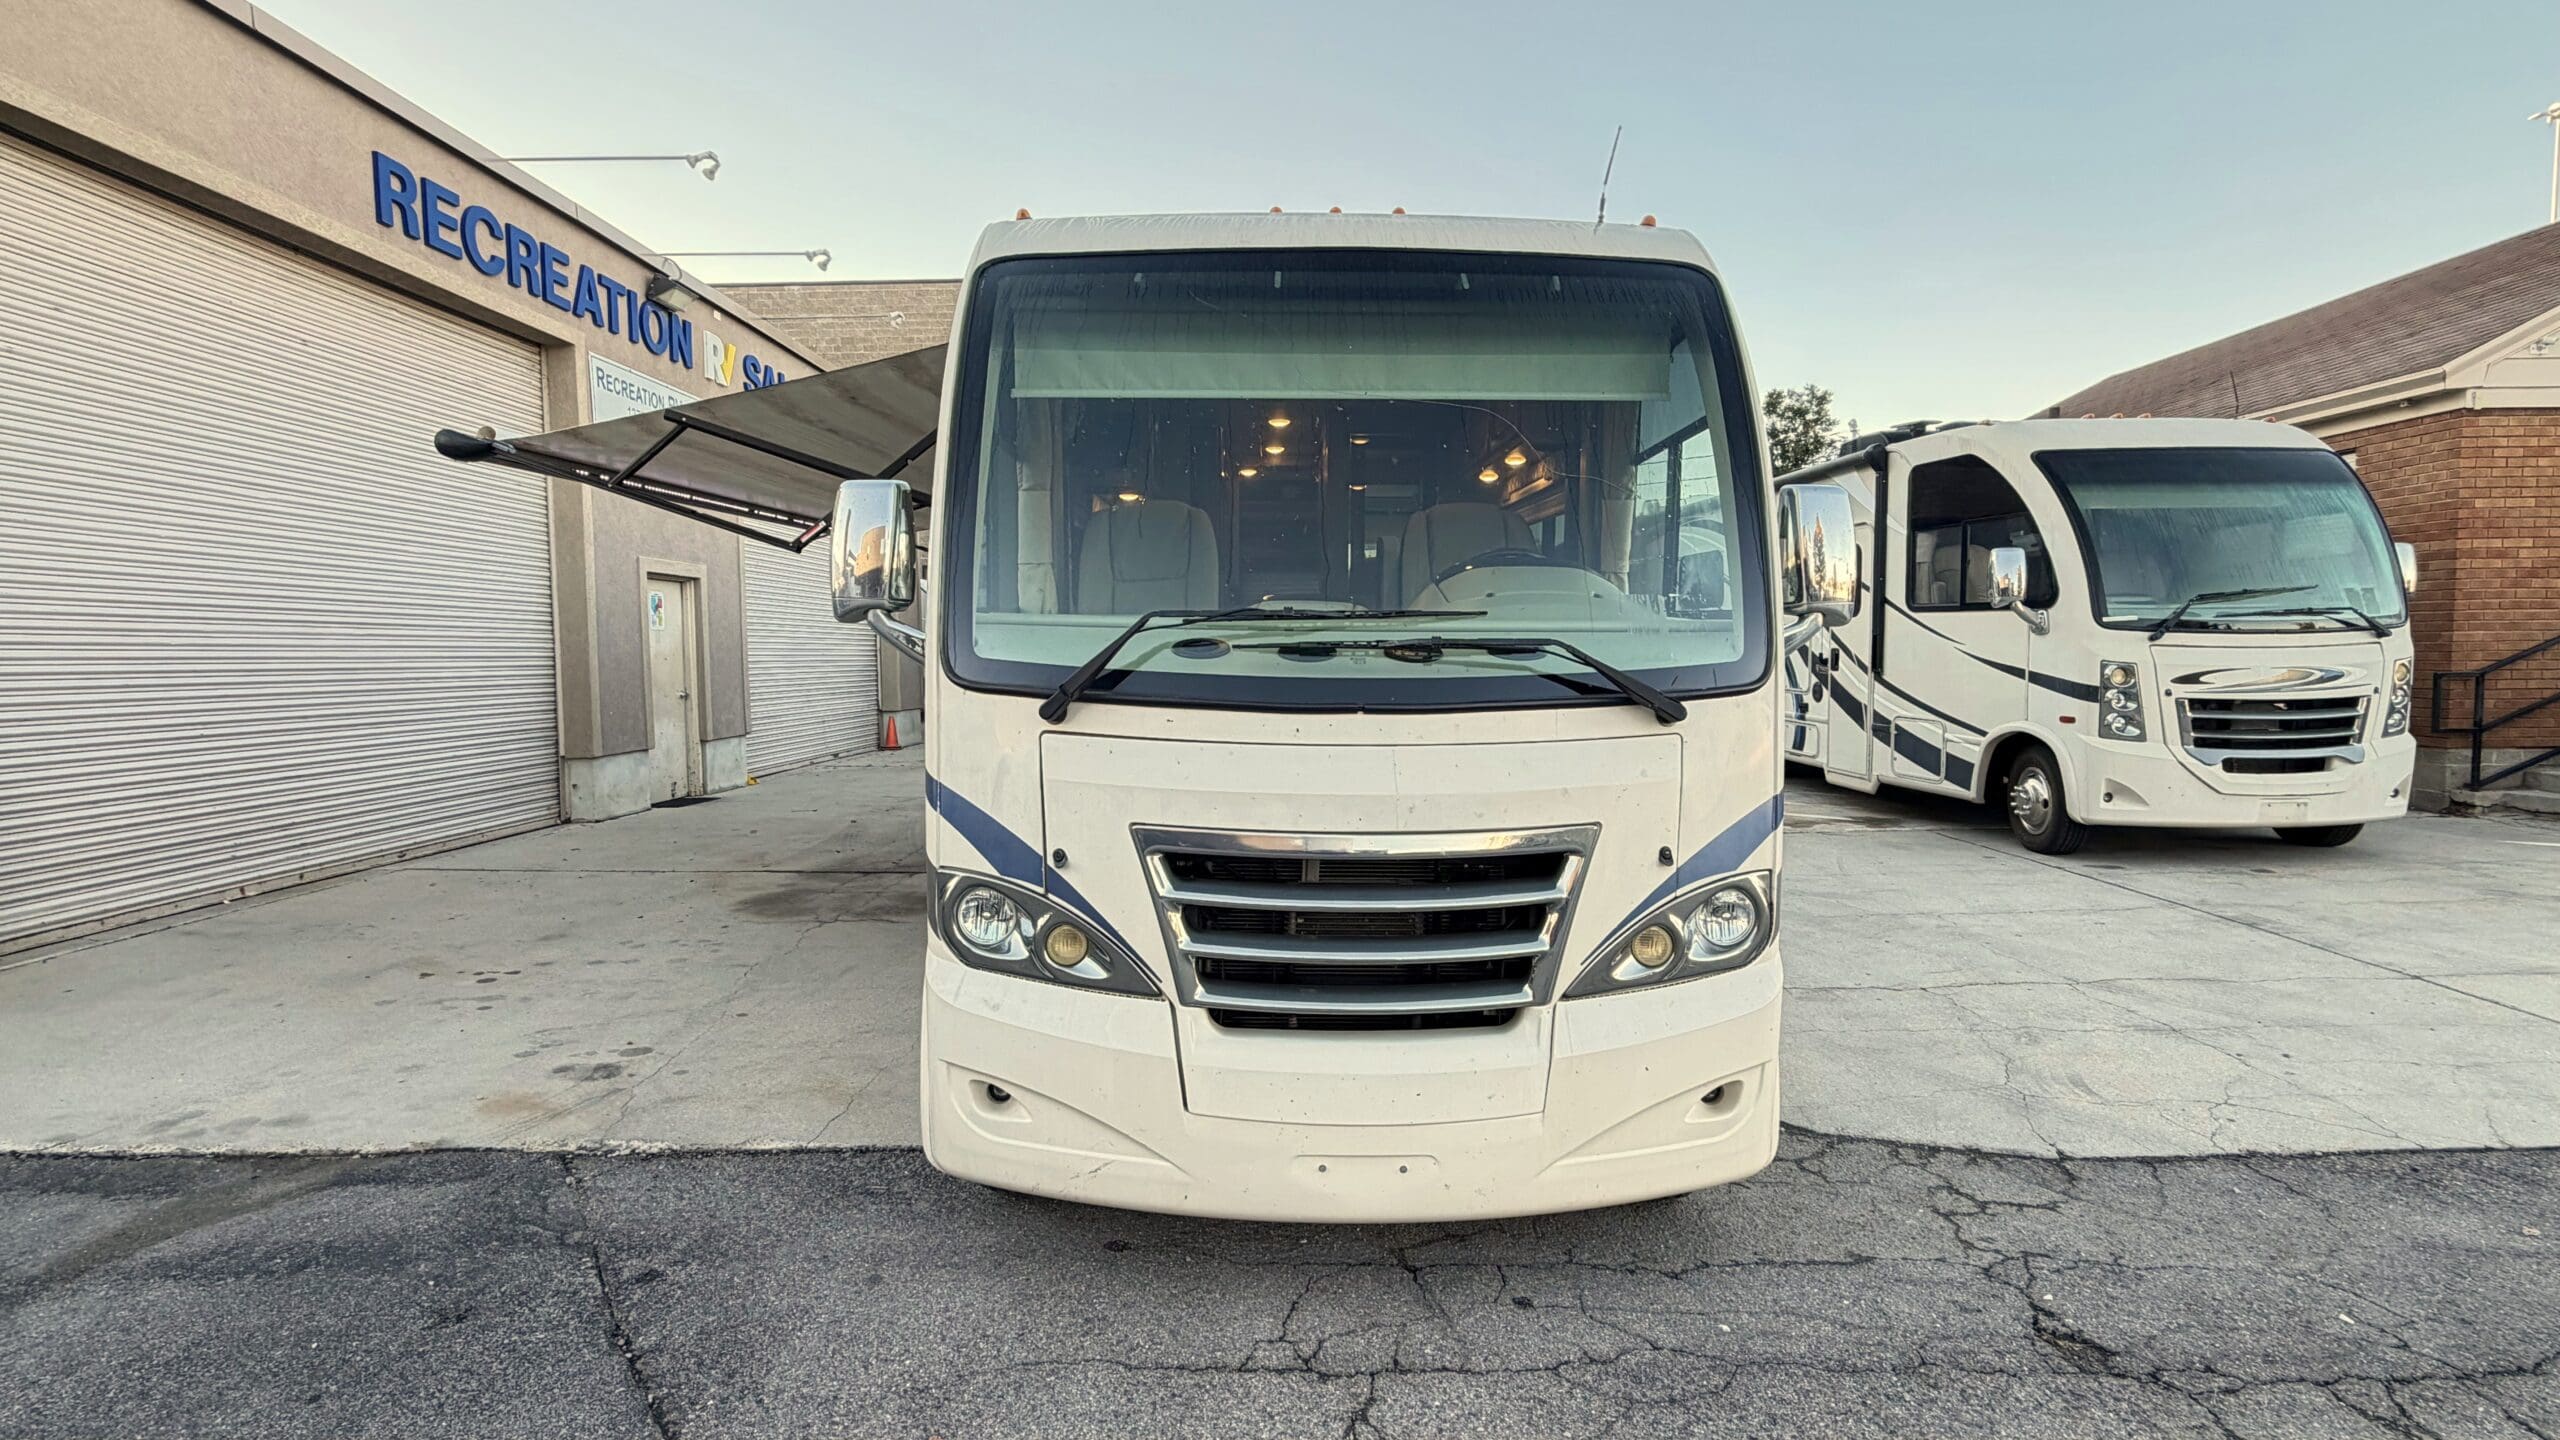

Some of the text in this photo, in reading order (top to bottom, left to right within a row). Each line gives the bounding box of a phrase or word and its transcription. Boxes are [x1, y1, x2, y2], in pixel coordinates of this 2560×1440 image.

[371, 150, 692, 368] RECREATION
[703, 330, 736, 387] RV
[596, 366, 664, 409] RECREATION
